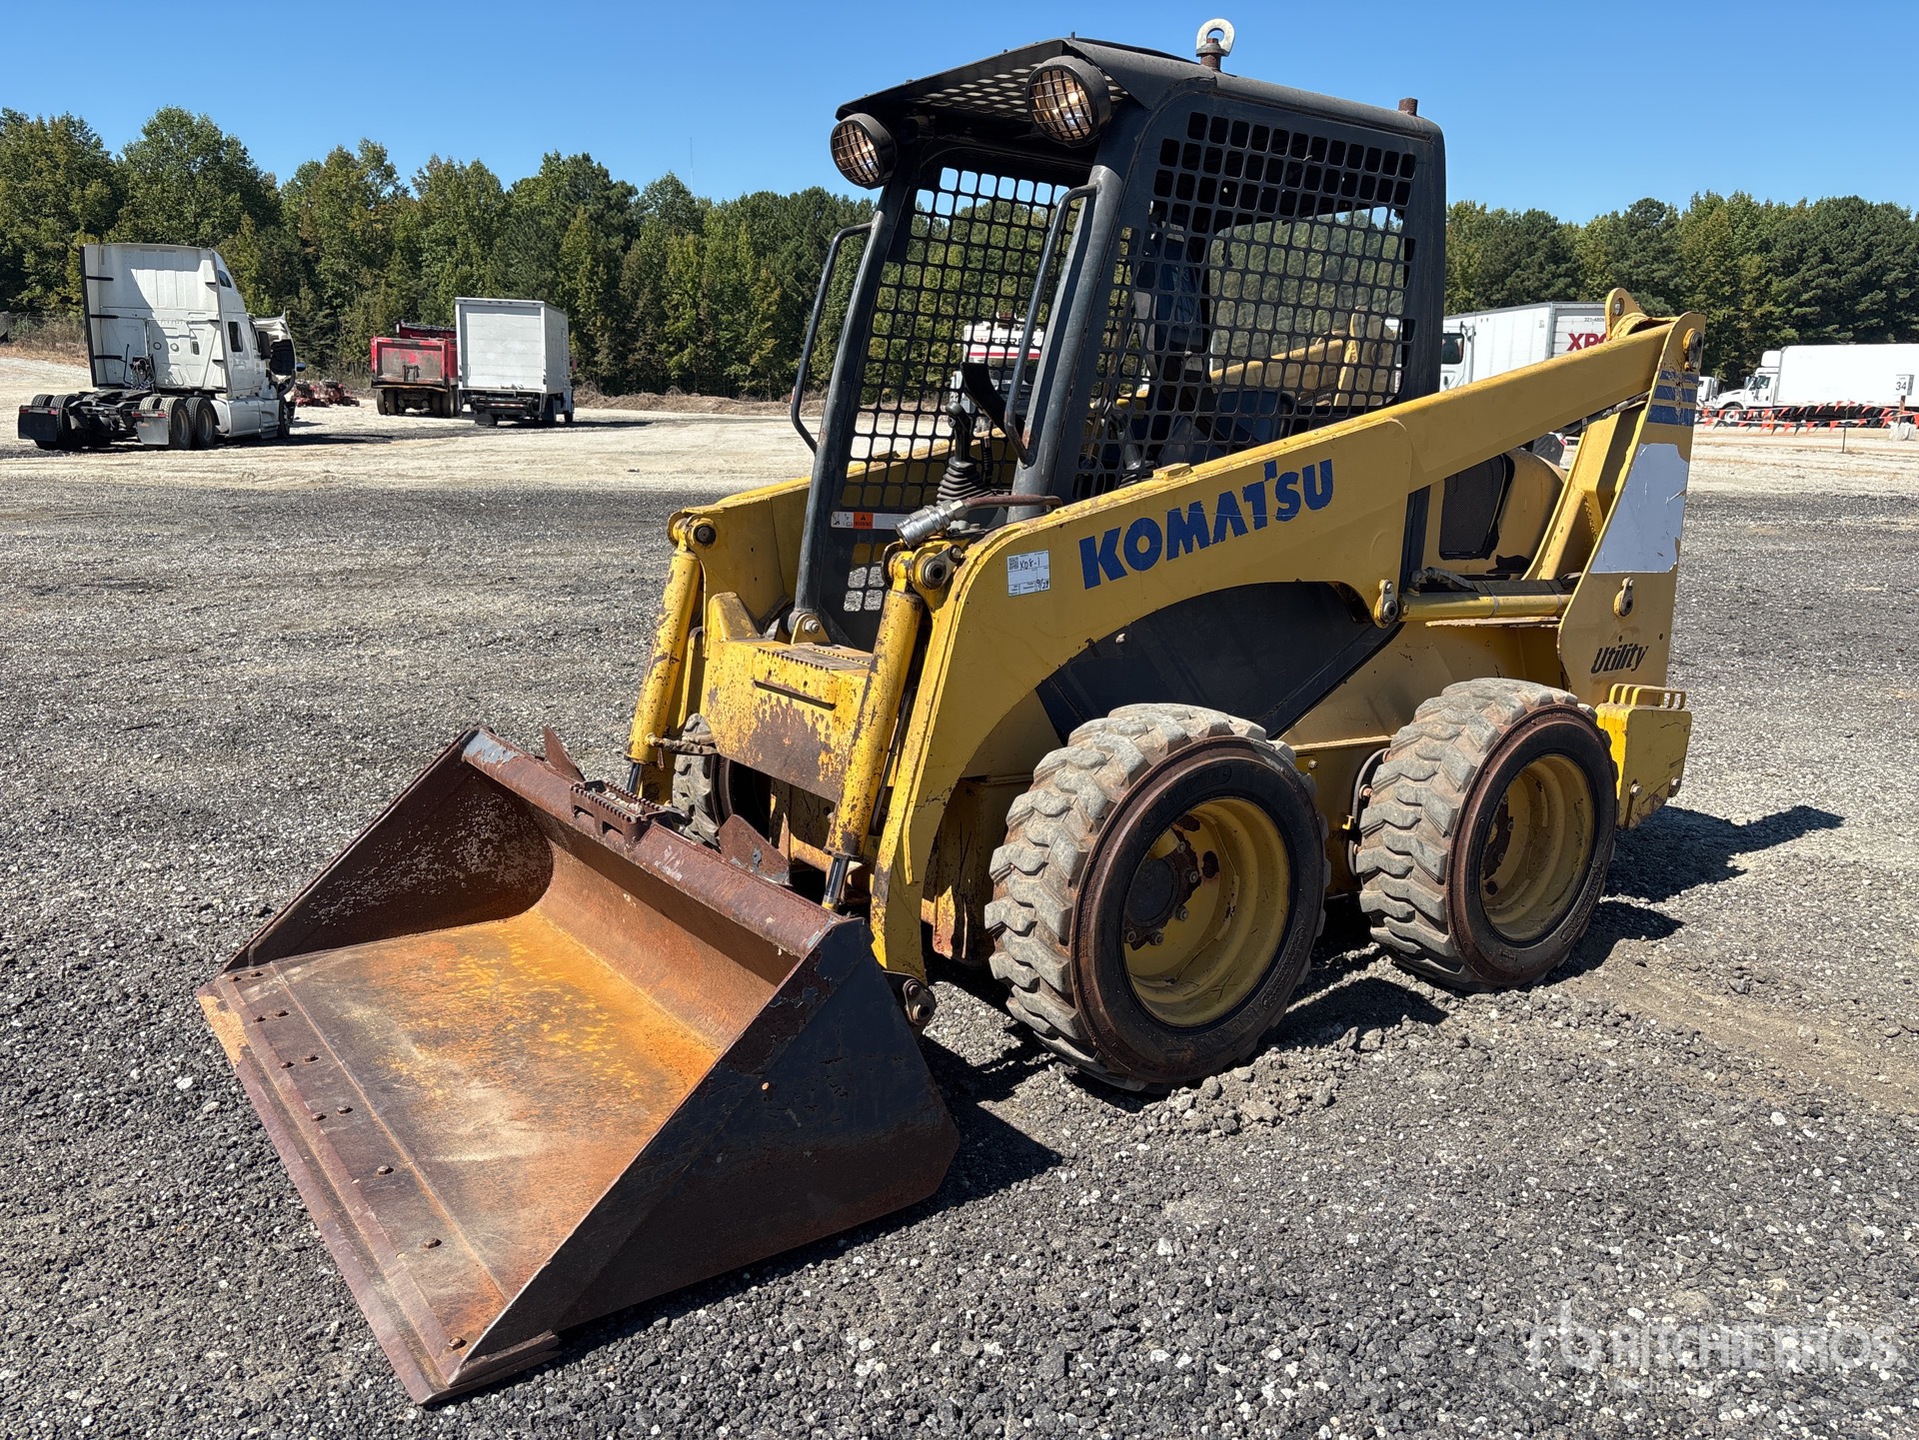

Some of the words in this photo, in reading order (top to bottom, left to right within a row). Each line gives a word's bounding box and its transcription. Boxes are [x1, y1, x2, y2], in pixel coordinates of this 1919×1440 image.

[1895, 381, 1907, 391] 34
[1079, 459, 1334, 590] KOMATSU
[1590, 643, 1649, 674] Utility
